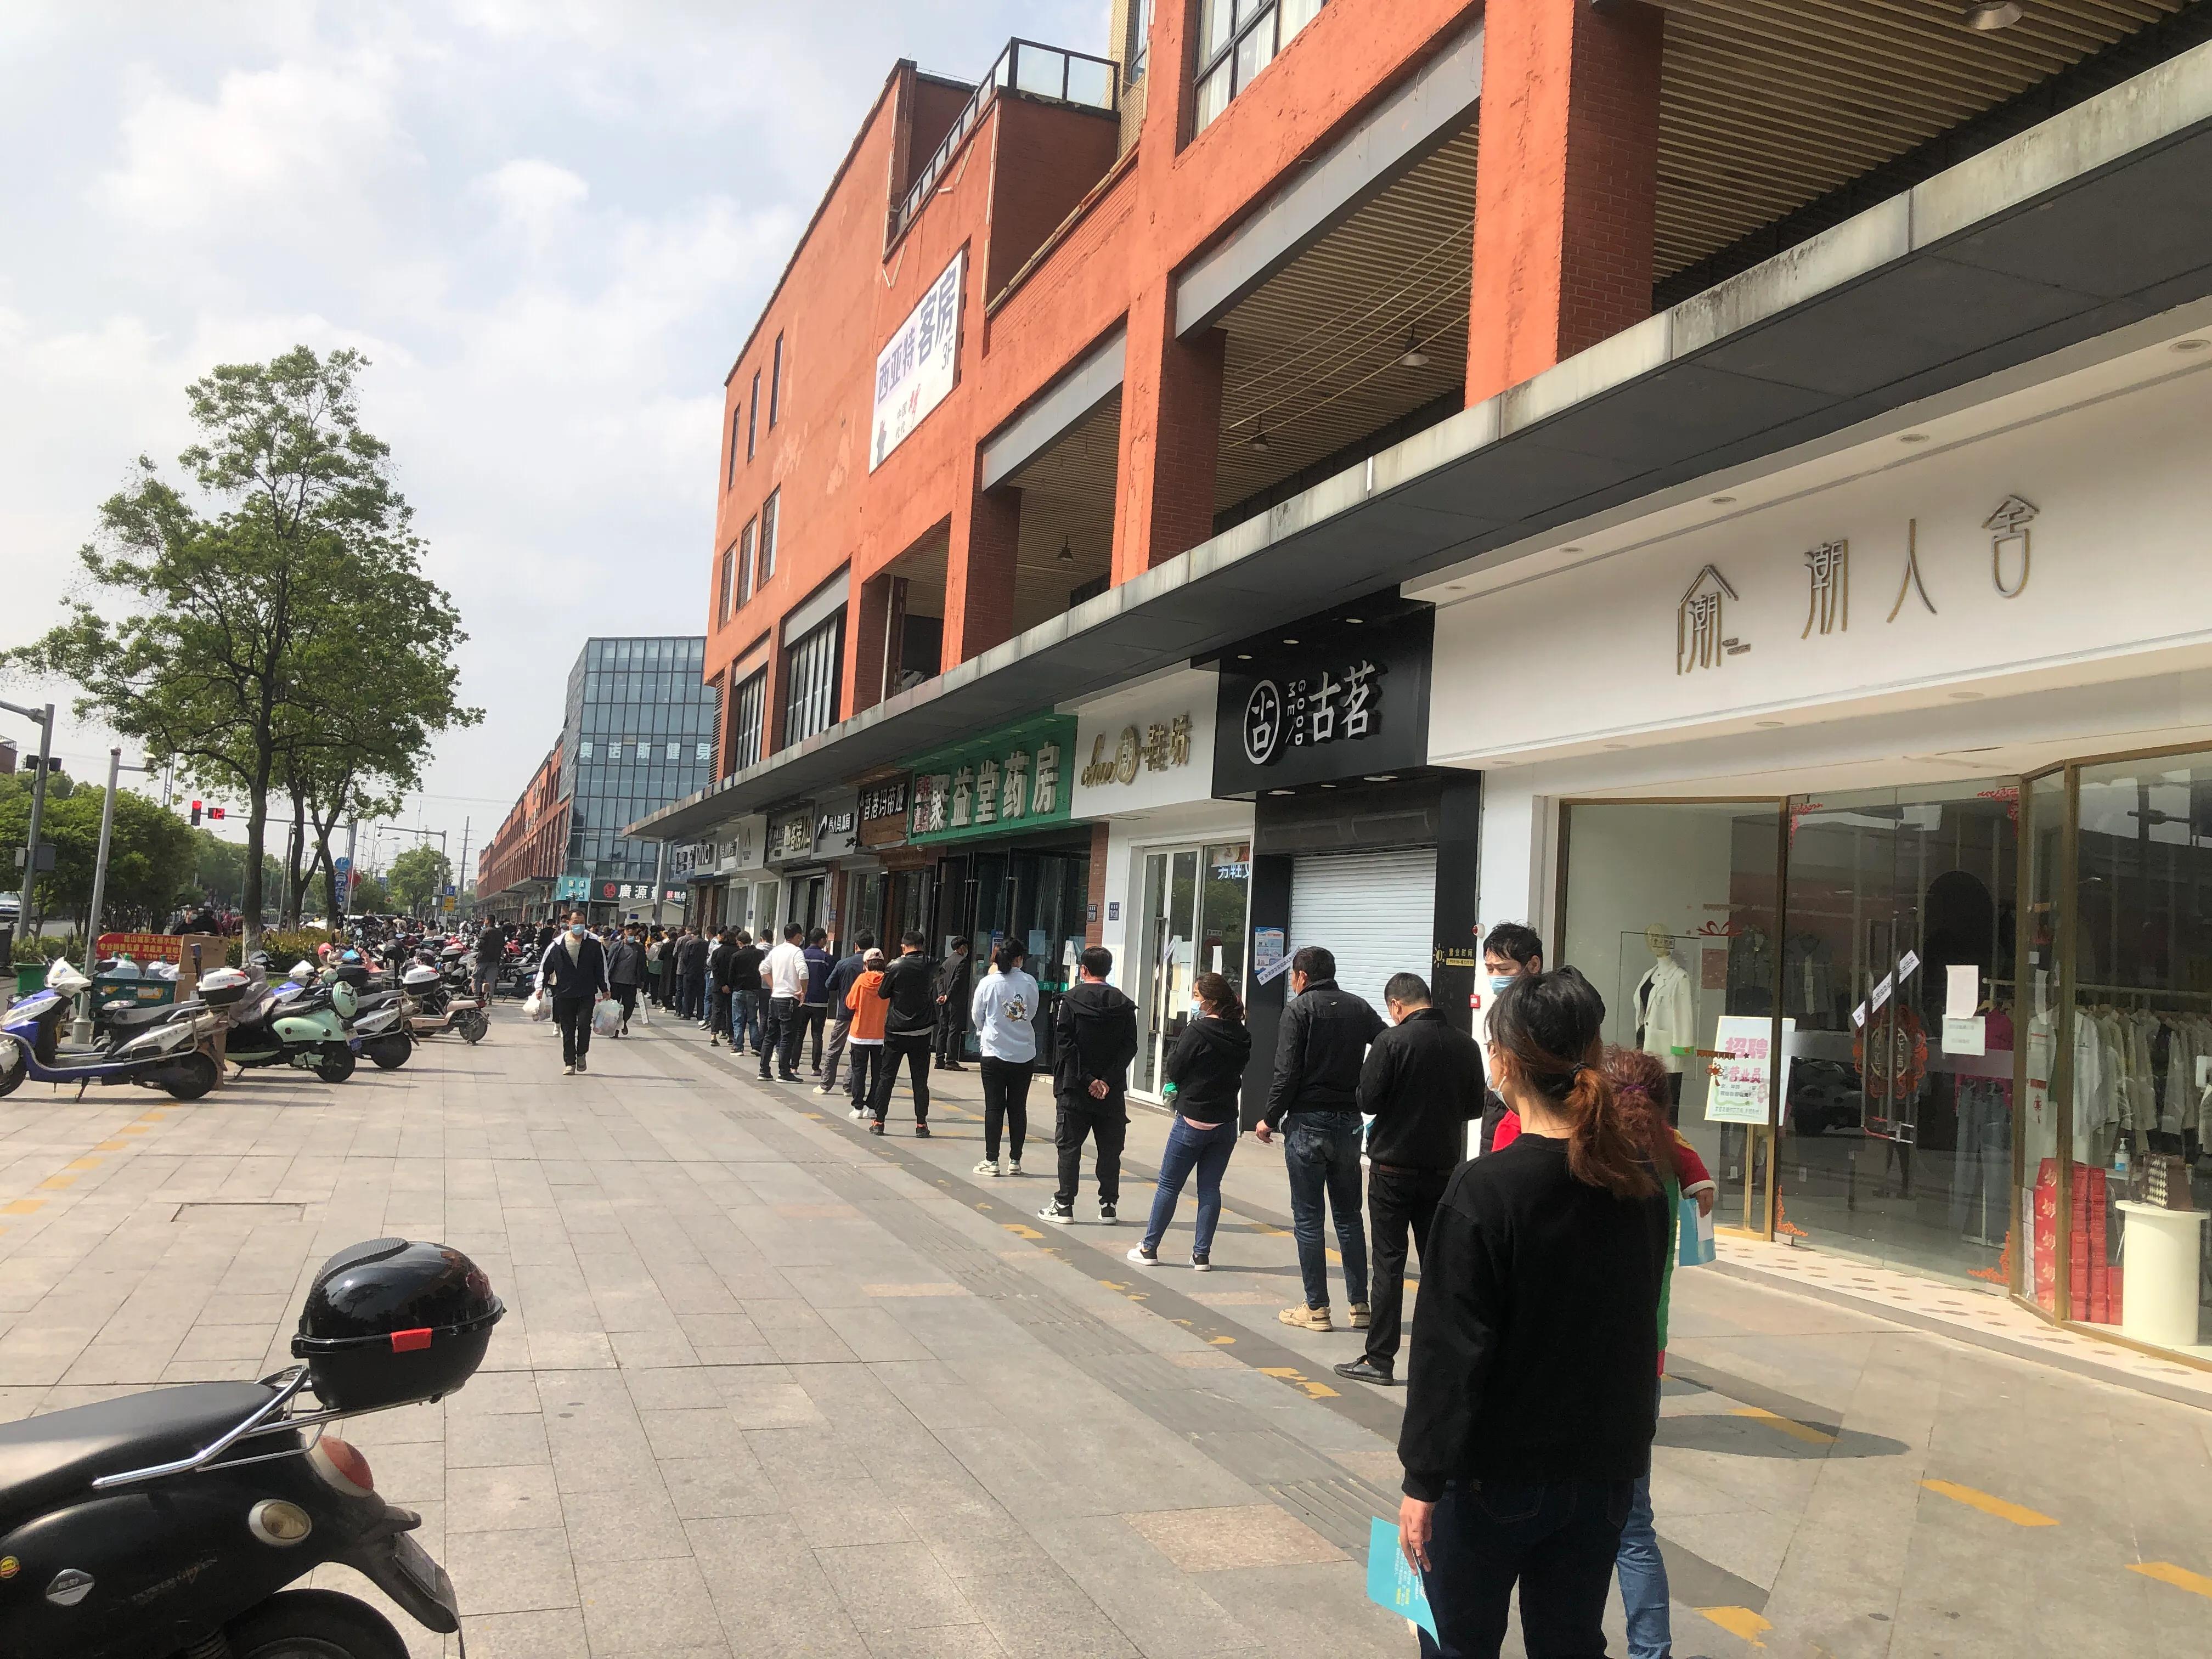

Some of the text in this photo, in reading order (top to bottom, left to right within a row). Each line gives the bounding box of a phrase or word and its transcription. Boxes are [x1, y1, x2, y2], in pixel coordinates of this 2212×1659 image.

[941, 335, 953, 371] 3F
[896, 401, 908, 421] 中国
[1801, 494, 2041, 640] 潮人舍
[1295, 679, 1306, 746] GOOD
[1308, 660, 1375, 742] 古茗
[579, 742, 711, 760] 奥诺斯健身
[929, 741, 1060, 831] 聚益堂药房
[1725, 1037, 1768, 1059] 招聘
